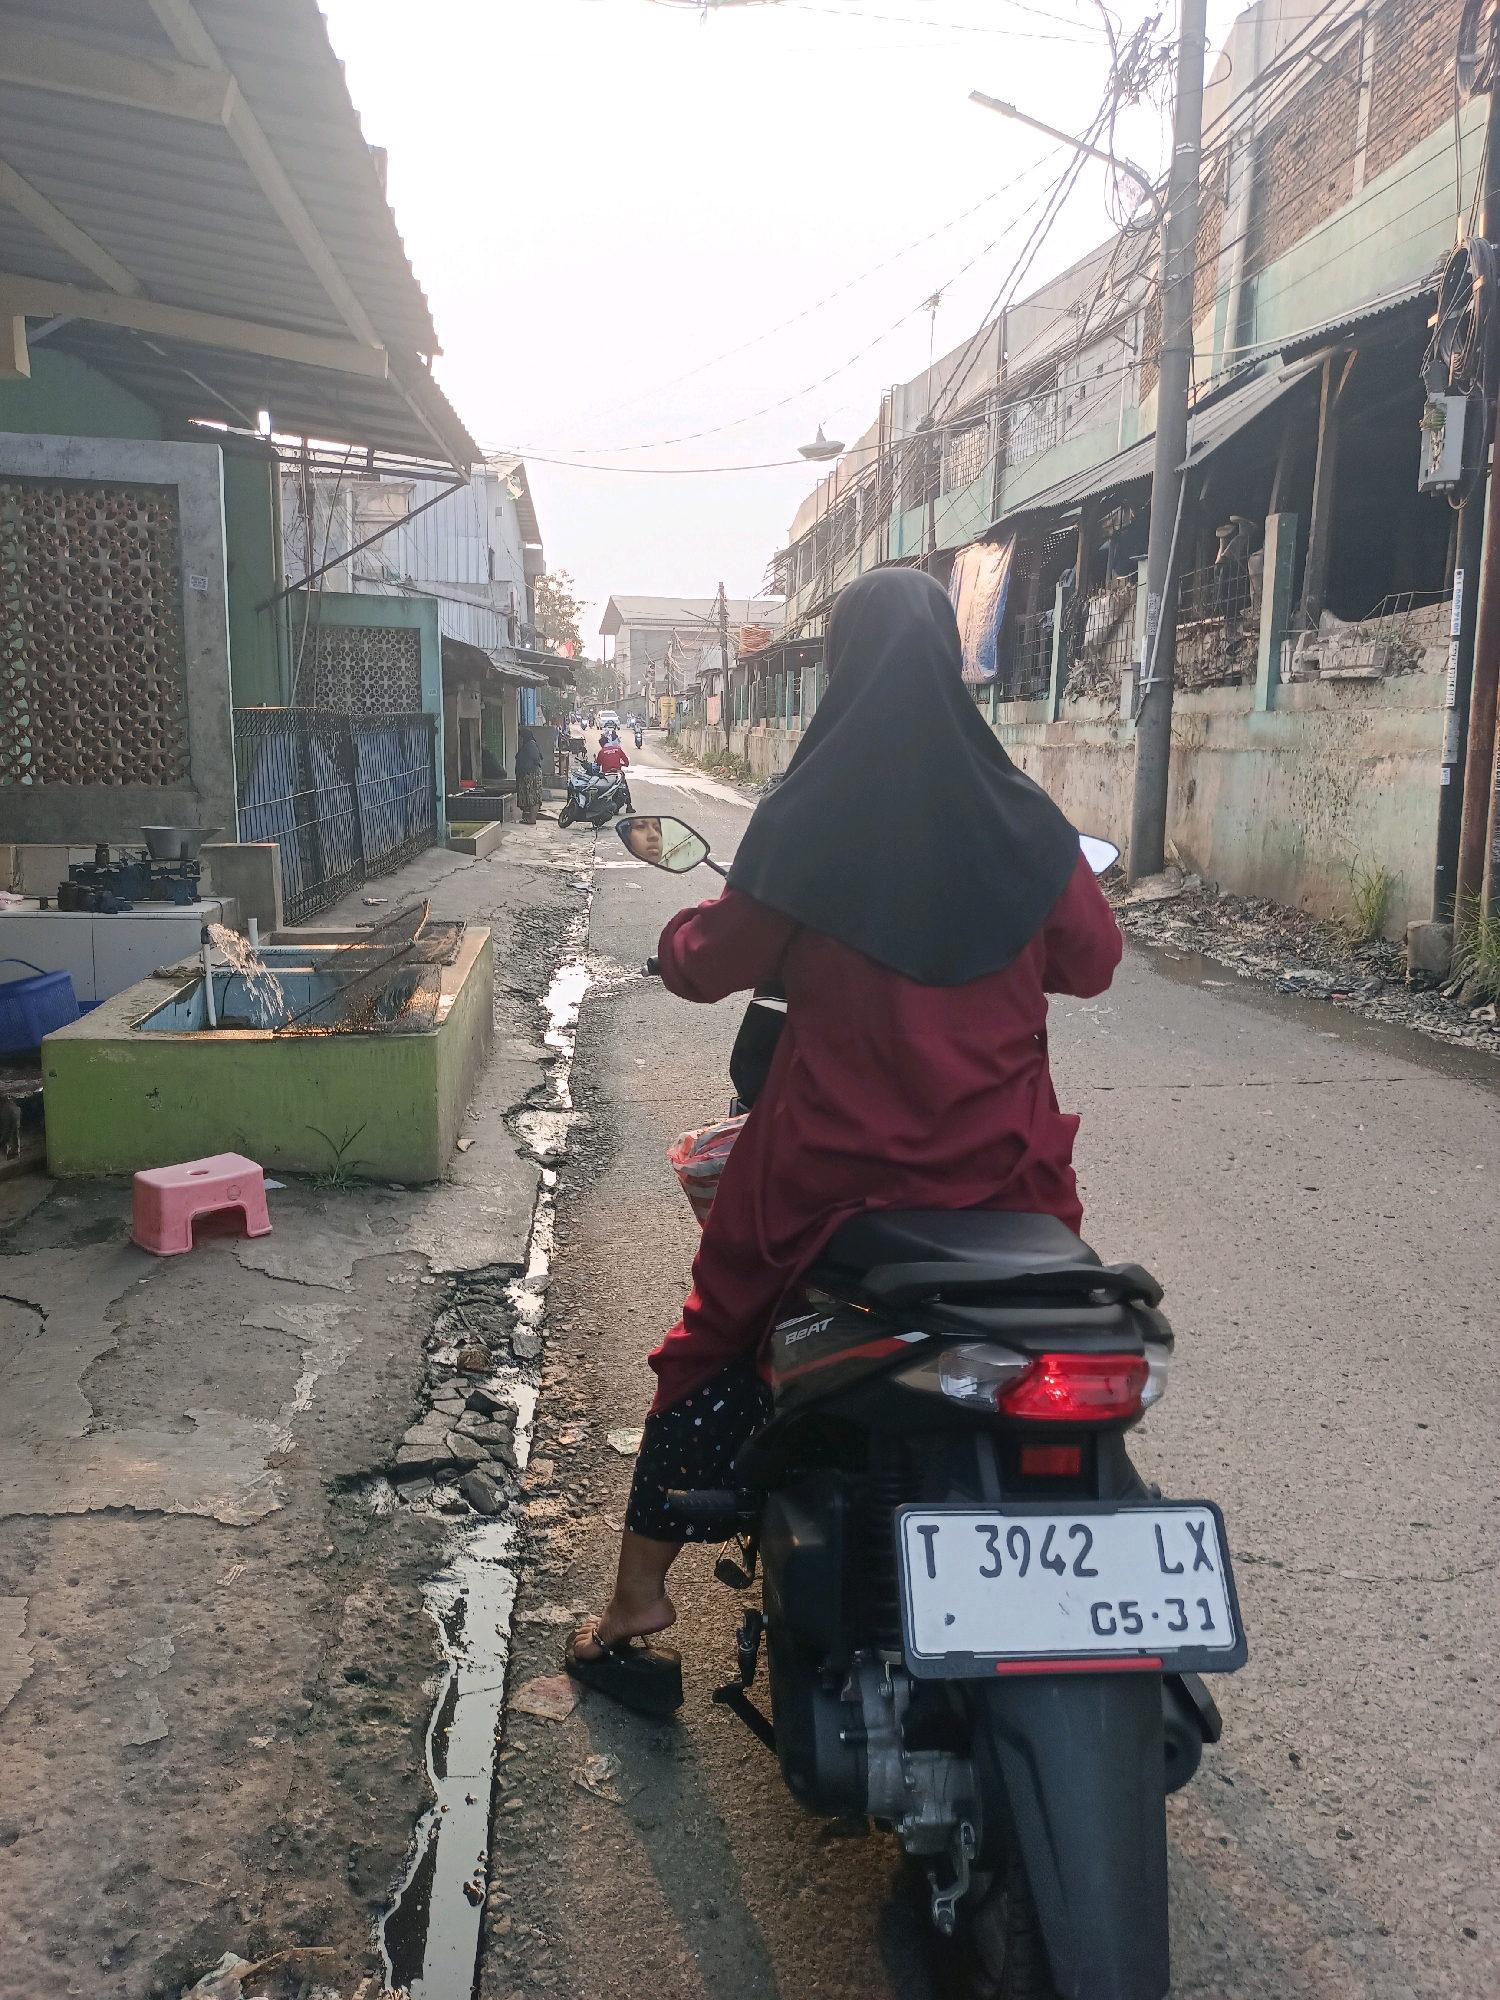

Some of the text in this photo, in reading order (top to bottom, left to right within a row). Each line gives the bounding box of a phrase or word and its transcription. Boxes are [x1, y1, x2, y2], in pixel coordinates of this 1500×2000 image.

[785, 1317, 834, 1345] BEAT
[916, 1521, 1215, 1580] T 3942 LX
